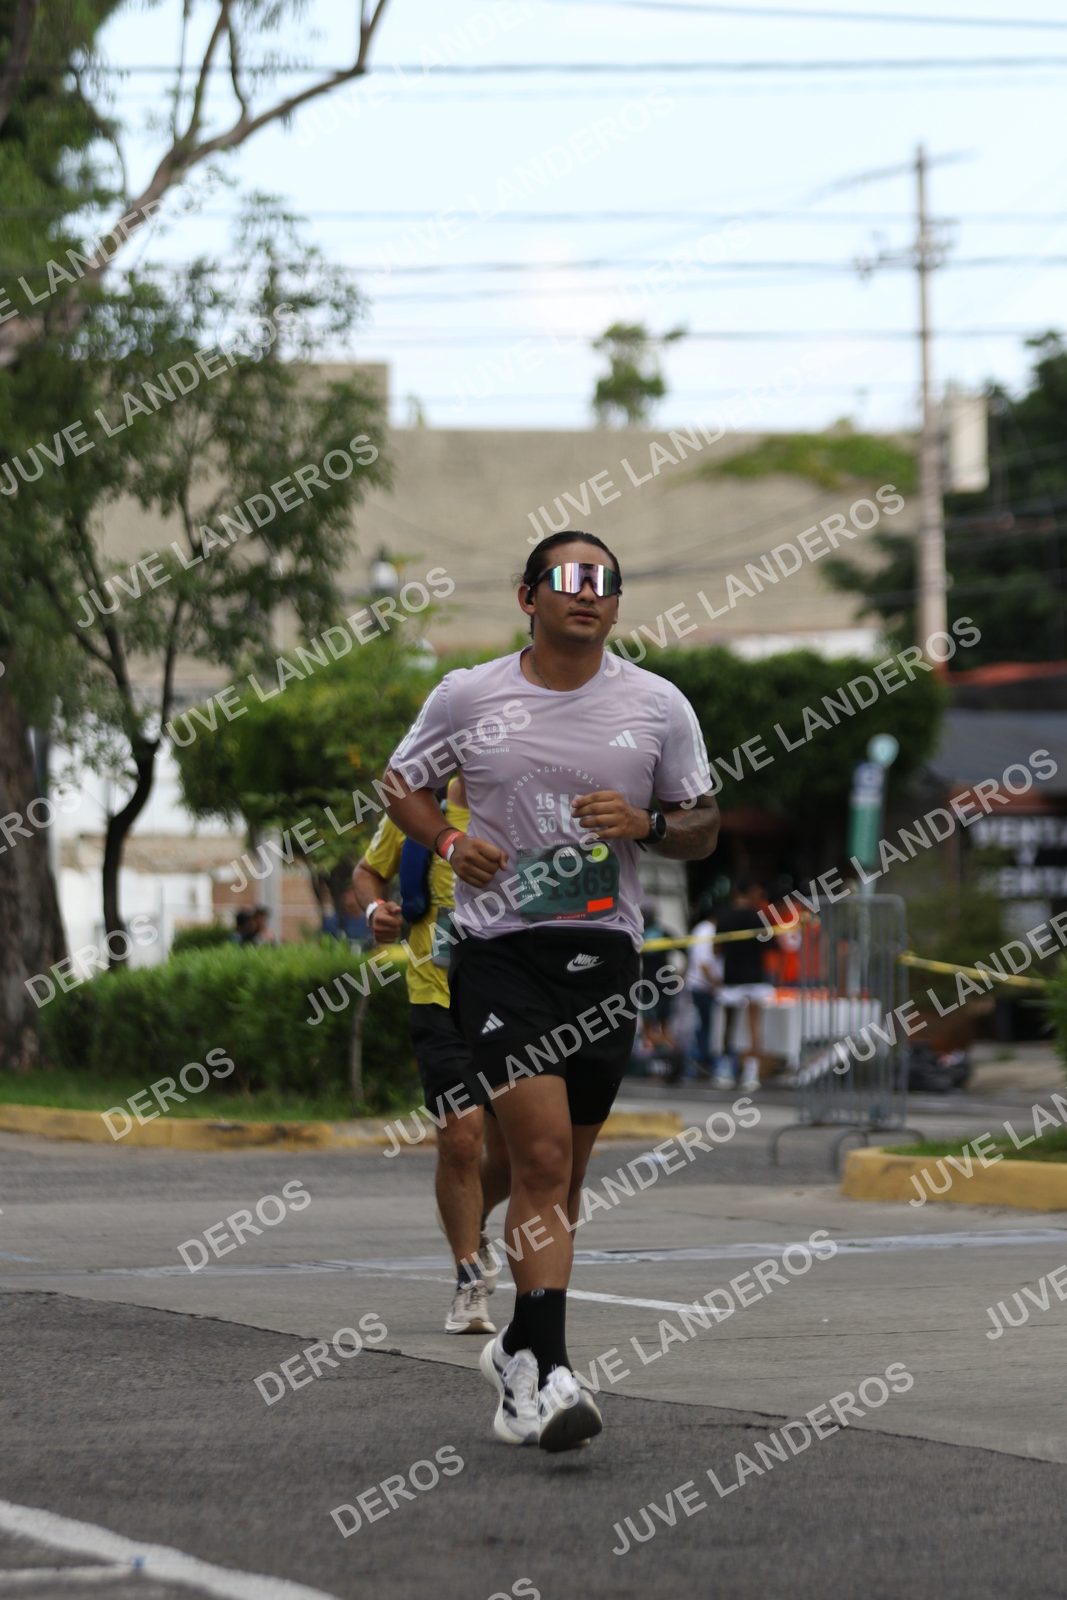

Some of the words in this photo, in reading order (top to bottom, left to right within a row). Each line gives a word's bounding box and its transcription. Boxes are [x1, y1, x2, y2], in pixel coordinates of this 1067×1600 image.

[535, 792, 555, 810] 15
[537, 816, 558, 834] 30
[574, 952, 600, 967] NIKE
